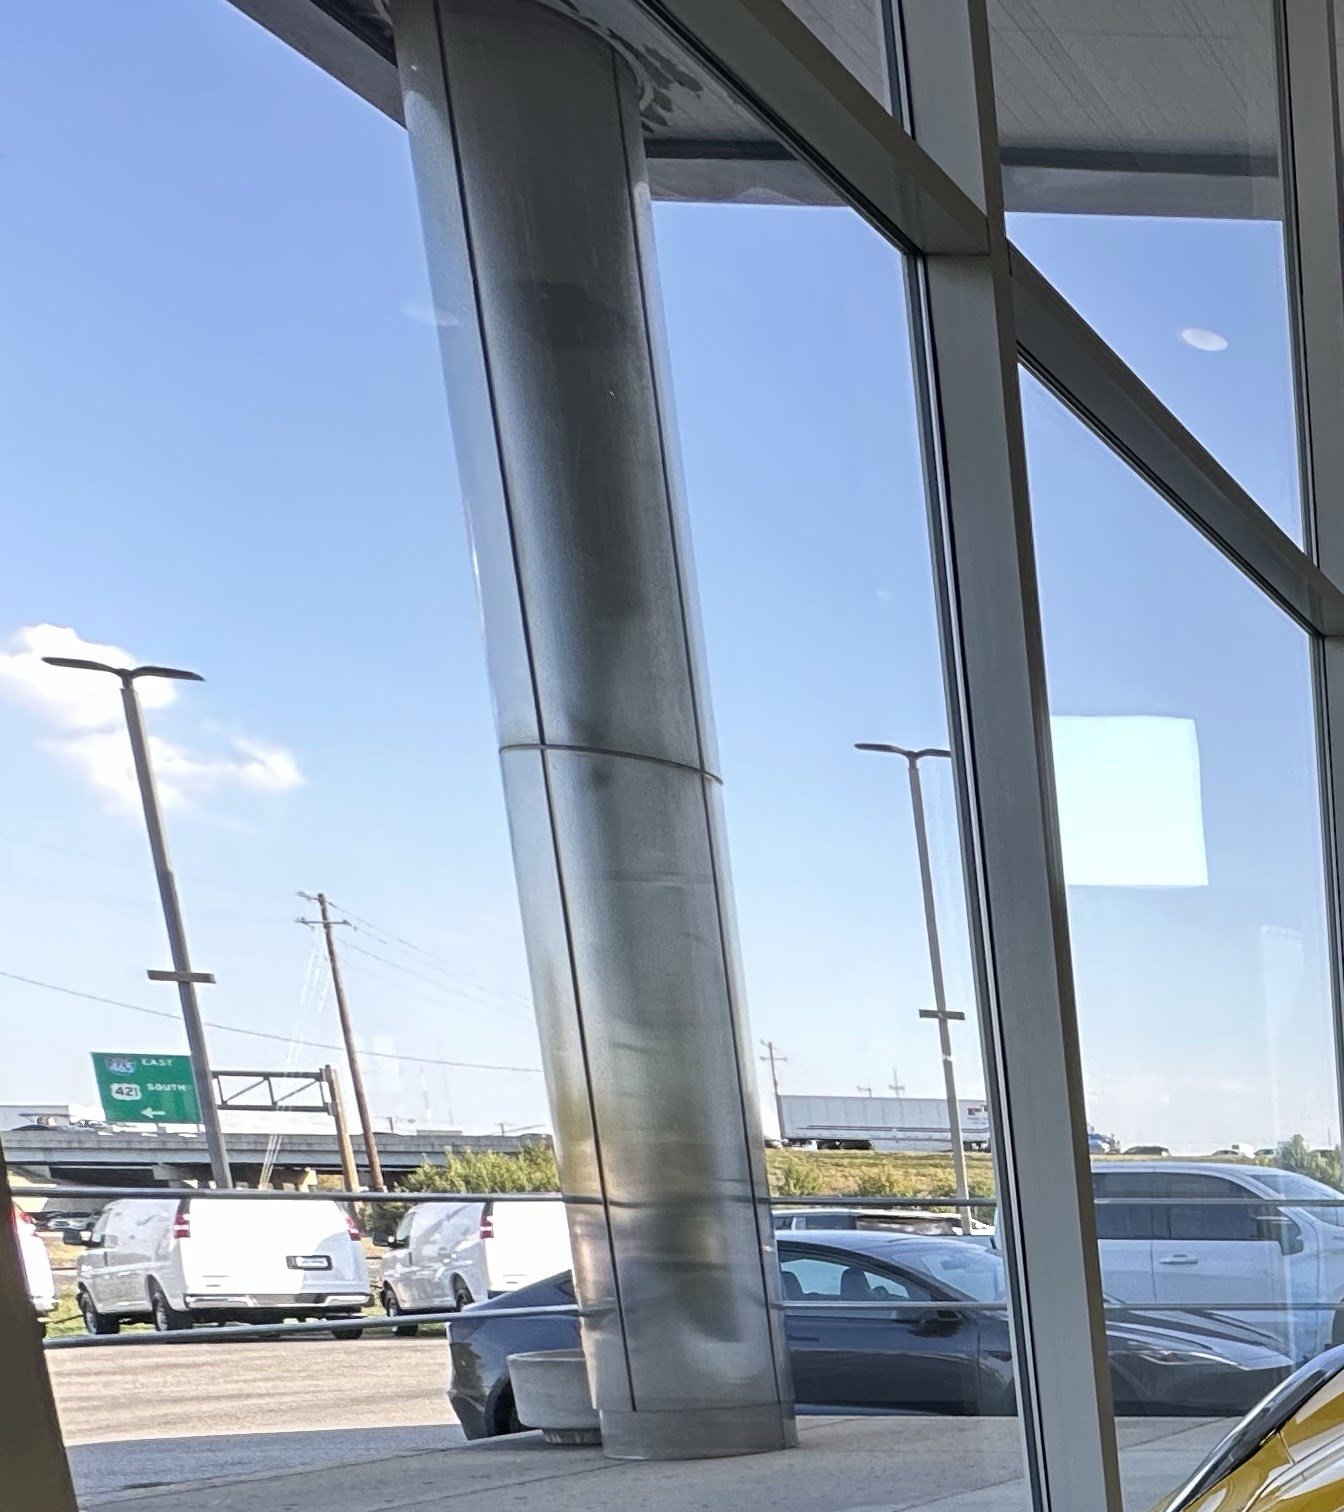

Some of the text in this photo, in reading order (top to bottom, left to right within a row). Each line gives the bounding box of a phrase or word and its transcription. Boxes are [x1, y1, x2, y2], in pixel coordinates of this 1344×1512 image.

[141, 1058, 173, 1067] EAST
[114, 1082, 188, 1097] 421 SOUTH
